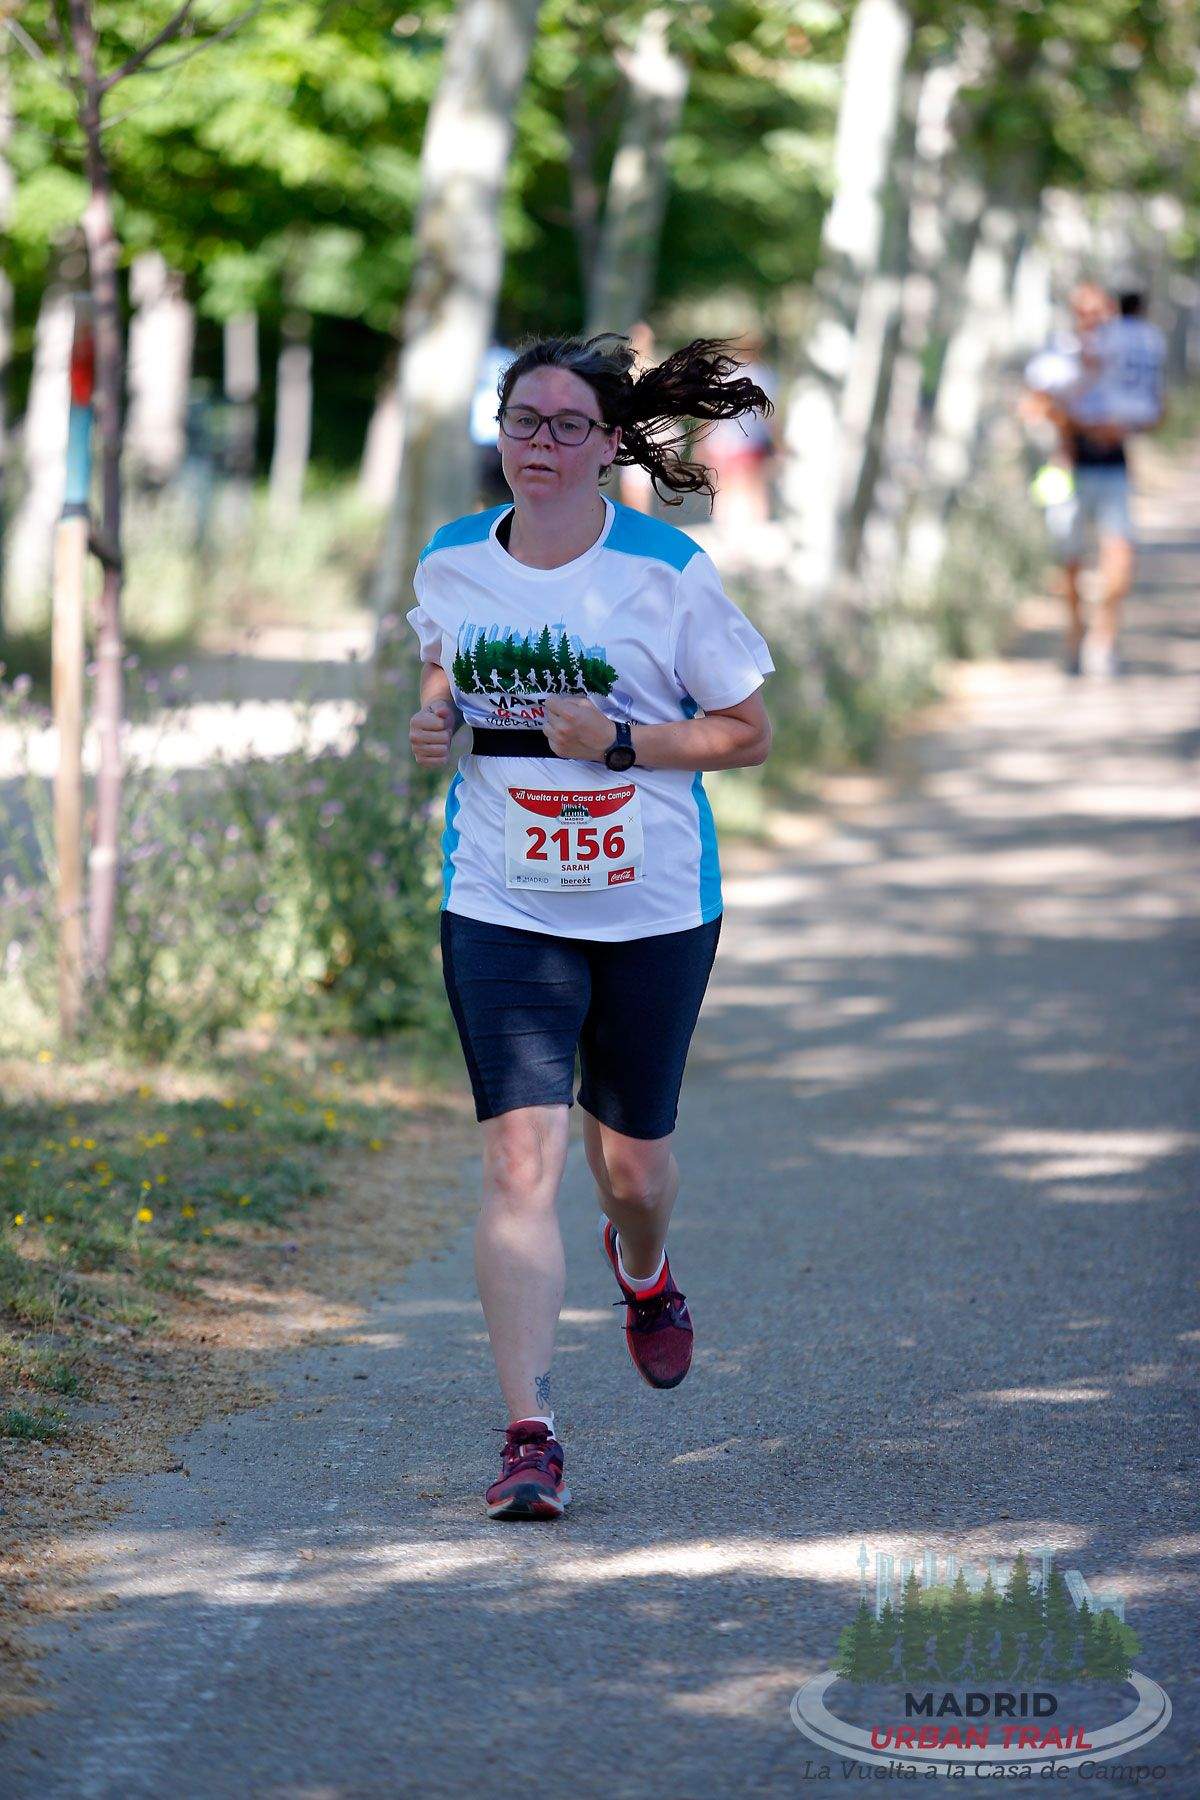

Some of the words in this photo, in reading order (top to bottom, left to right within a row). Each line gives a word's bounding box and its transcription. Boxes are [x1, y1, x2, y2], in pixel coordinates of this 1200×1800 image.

[527, 793, 551, 801] Vuelta
[561, 794, 569, 802] la
[572, 794, 593, 802] Casa
[596, 793, 605, 801] de
[607, 791, 631, 800] Campo
[526, 825, 625, 861] 2156
